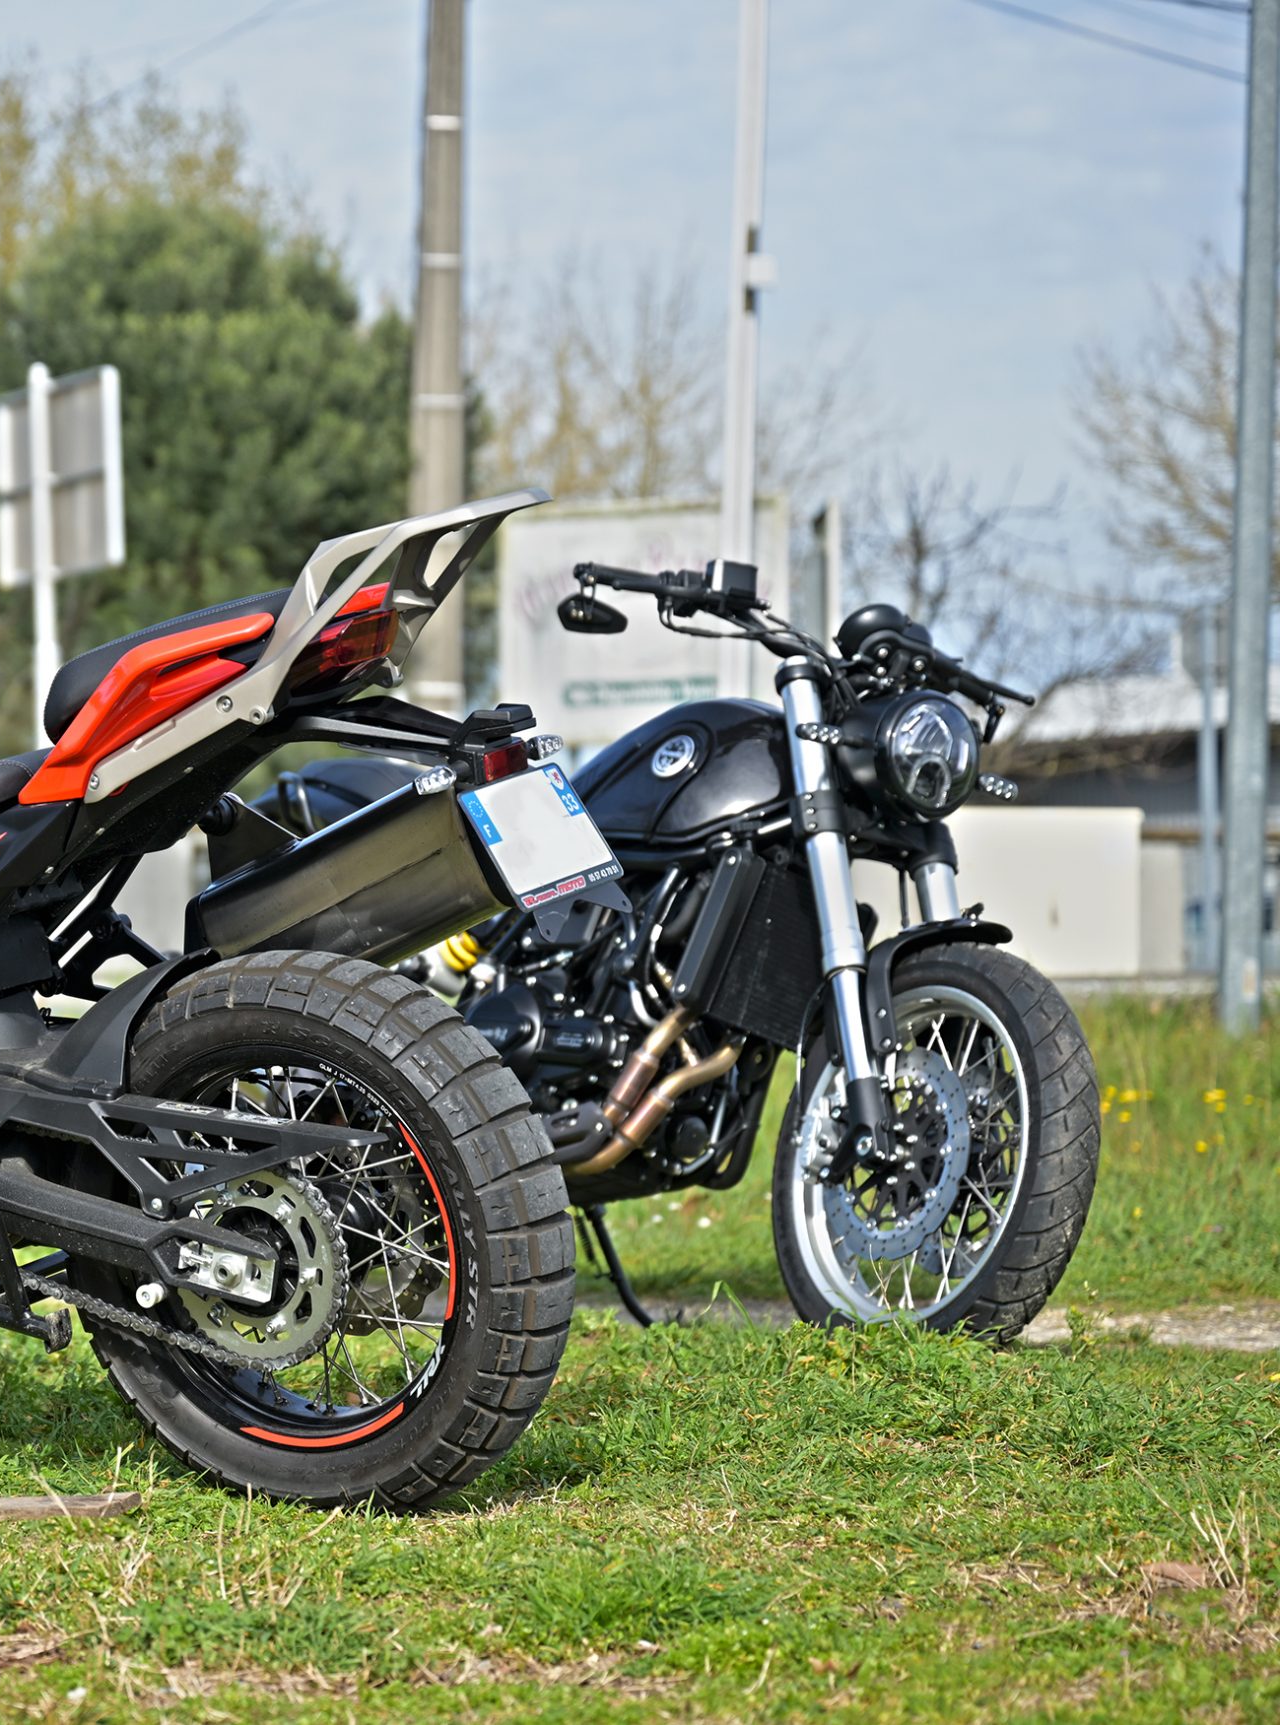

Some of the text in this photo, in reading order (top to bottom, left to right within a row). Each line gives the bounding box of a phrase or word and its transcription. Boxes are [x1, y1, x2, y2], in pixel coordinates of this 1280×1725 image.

[561, 793, 580, 813] 33
[482, 824, 493, 838] F
[380, 1105, 392, 1117] DOT
[289, 1023, 480, 1329] SCORPION RALLY STR
[410, 1337, 446, 1398] TRK
